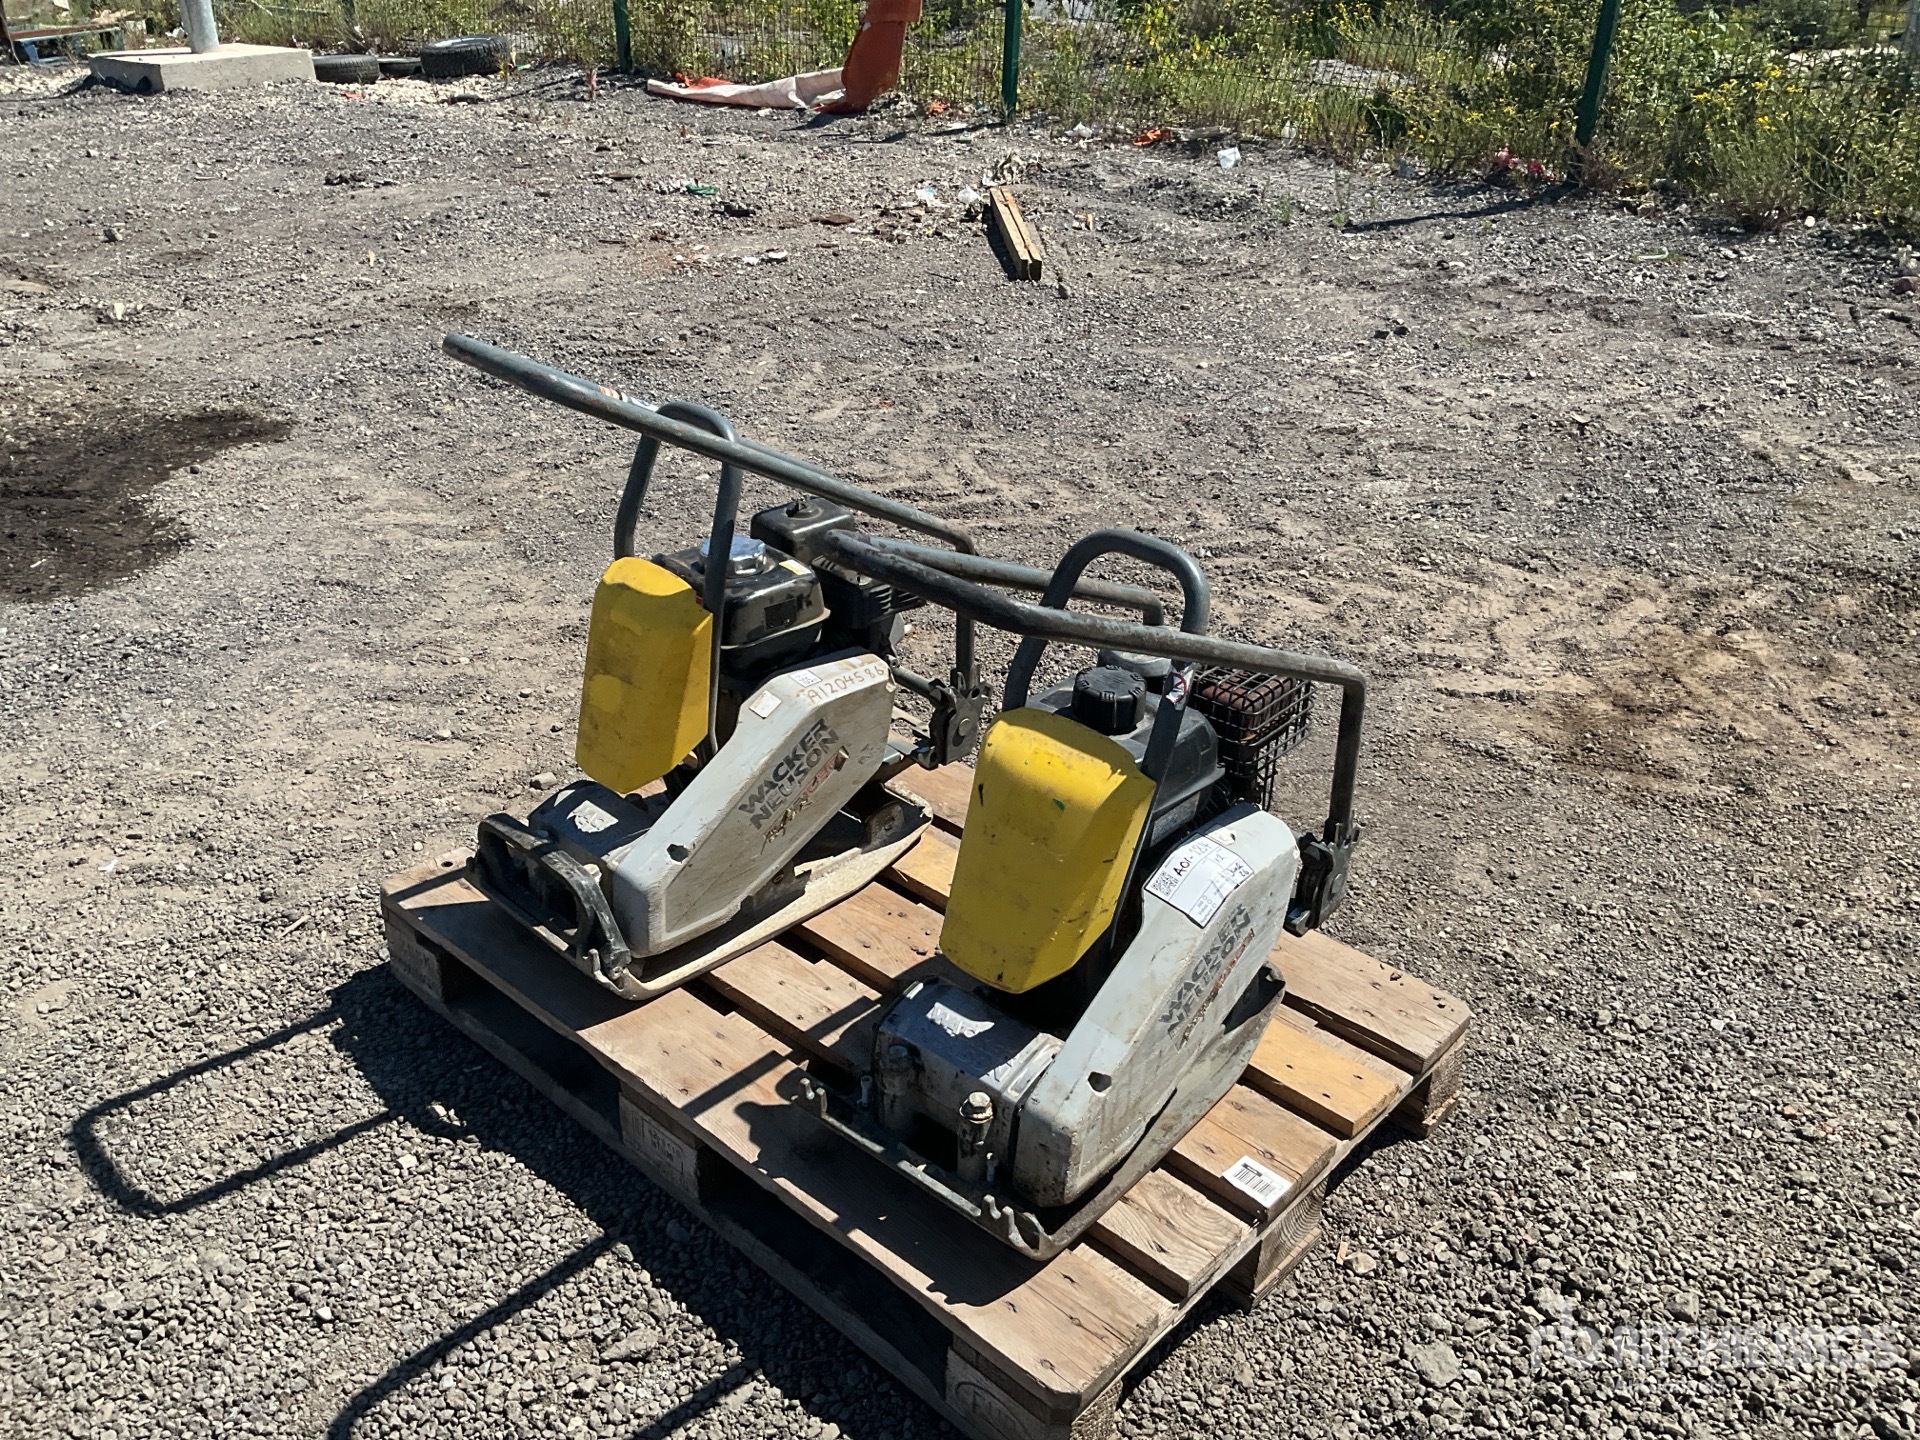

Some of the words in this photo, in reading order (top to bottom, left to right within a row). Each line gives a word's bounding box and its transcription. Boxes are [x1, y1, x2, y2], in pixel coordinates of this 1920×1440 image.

[807, 665, 885, 703] A1204586
[738, 718, 830, 814] WACKER
[749, 727, 840, 830] NEUSON
[1158, 903, 1247, 1023] WACKER
